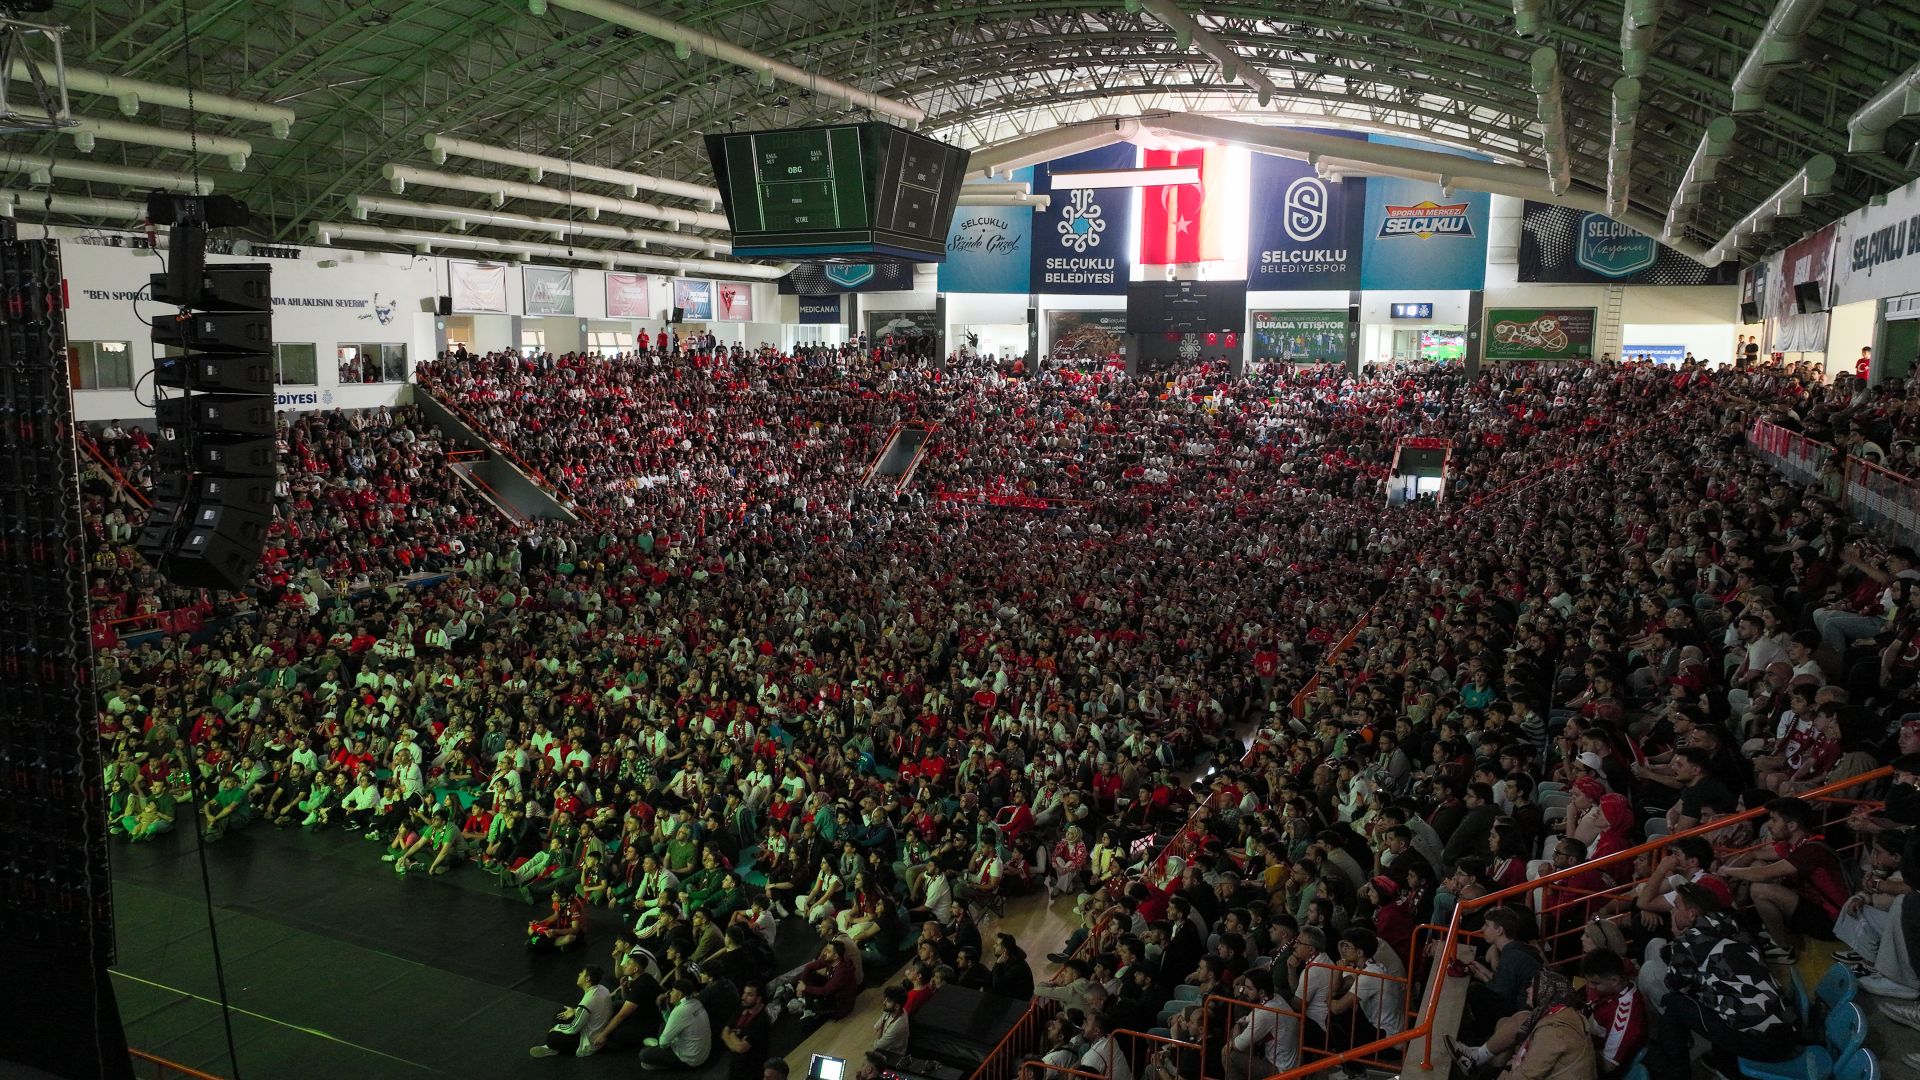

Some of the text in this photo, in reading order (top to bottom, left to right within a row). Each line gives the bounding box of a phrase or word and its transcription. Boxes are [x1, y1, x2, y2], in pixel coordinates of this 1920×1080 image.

[1391, 209, 1423, 217] SPORUN
[961, 217, 1008, 230] SELÇUKLU
[1385, 217, 1464, 233] SELÇUKLU
[986, 234, 1021, 255] Güzel
[1588, 238, 1646, 261] Vizyonu
[1852, 219, 1907, 277] SELÇUKLU
[1261, 249, 1347, 264] SELÇUKLU
[1046, 258, 1114, 272] SELÇUKLU
[1261, 264, 1346, 273] BELEDİYESPOR
[1045, 271, 1114, 284] BELEDİYESİ
[800, 305, 835, 313] MEDICANA
[1256, 321, 1344, 331] BURADA YETİŞİYOR
